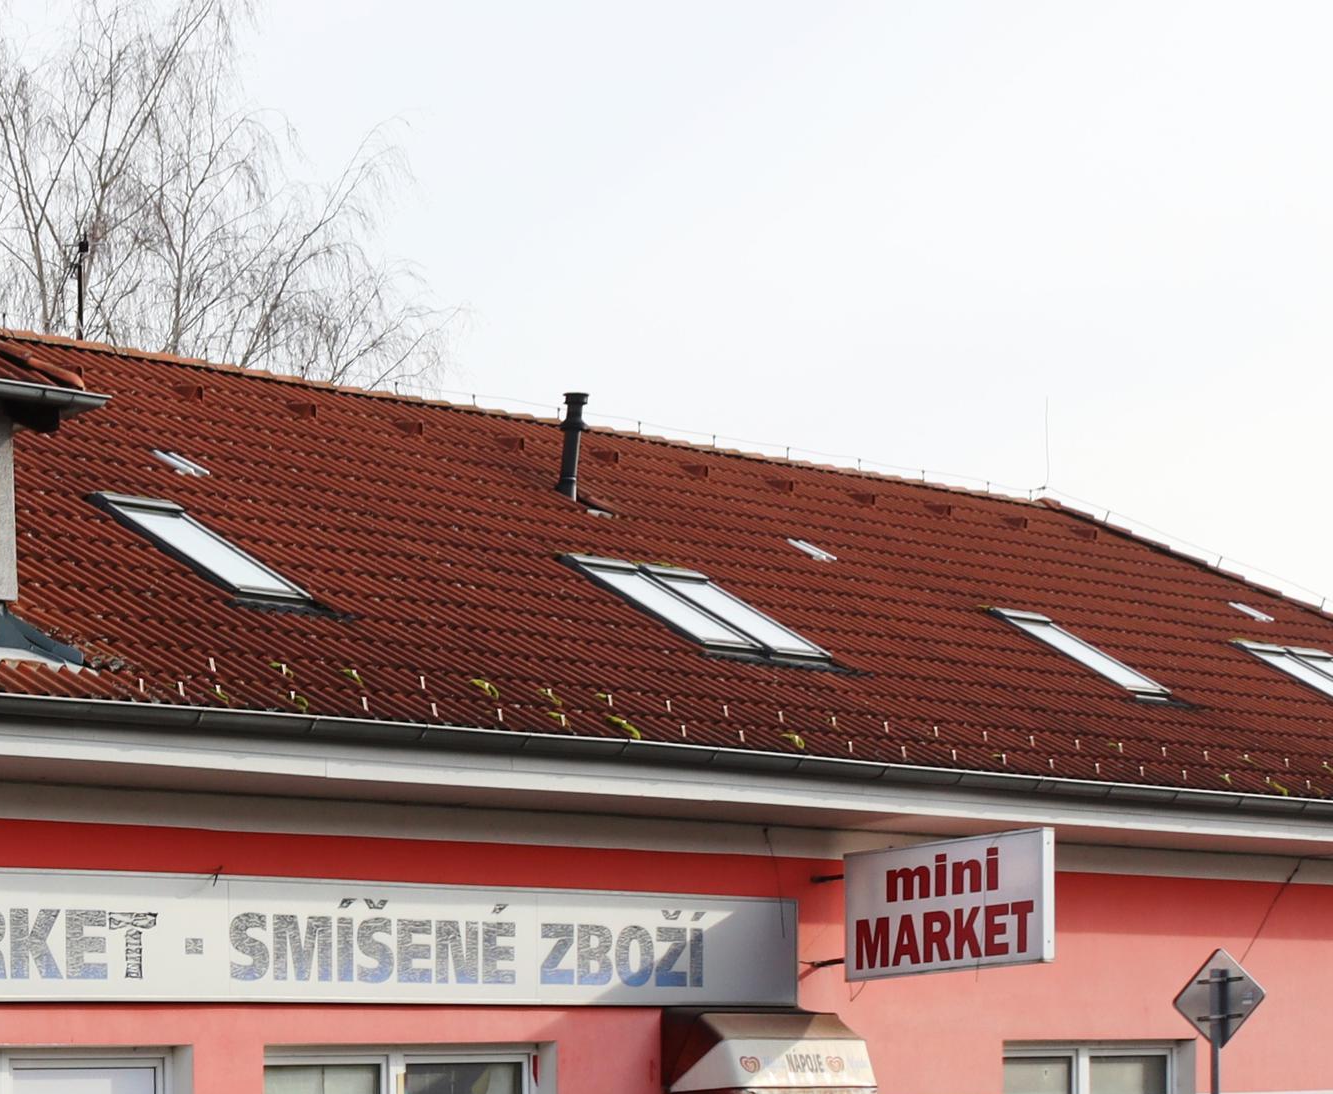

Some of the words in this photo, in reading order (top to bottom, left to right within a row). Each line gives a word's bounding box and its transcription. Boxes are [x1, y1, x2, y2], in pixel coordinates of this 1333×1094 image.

[886, 847, 999, 903] mini
[229, 897, 516, 985] SMÍŠENÉ
[540, 909, 706, 988] ZBOŽÍ
[856, 900, 1034, 971] MARKET
[785, 1048, 825, 1073] NÁPOJE
